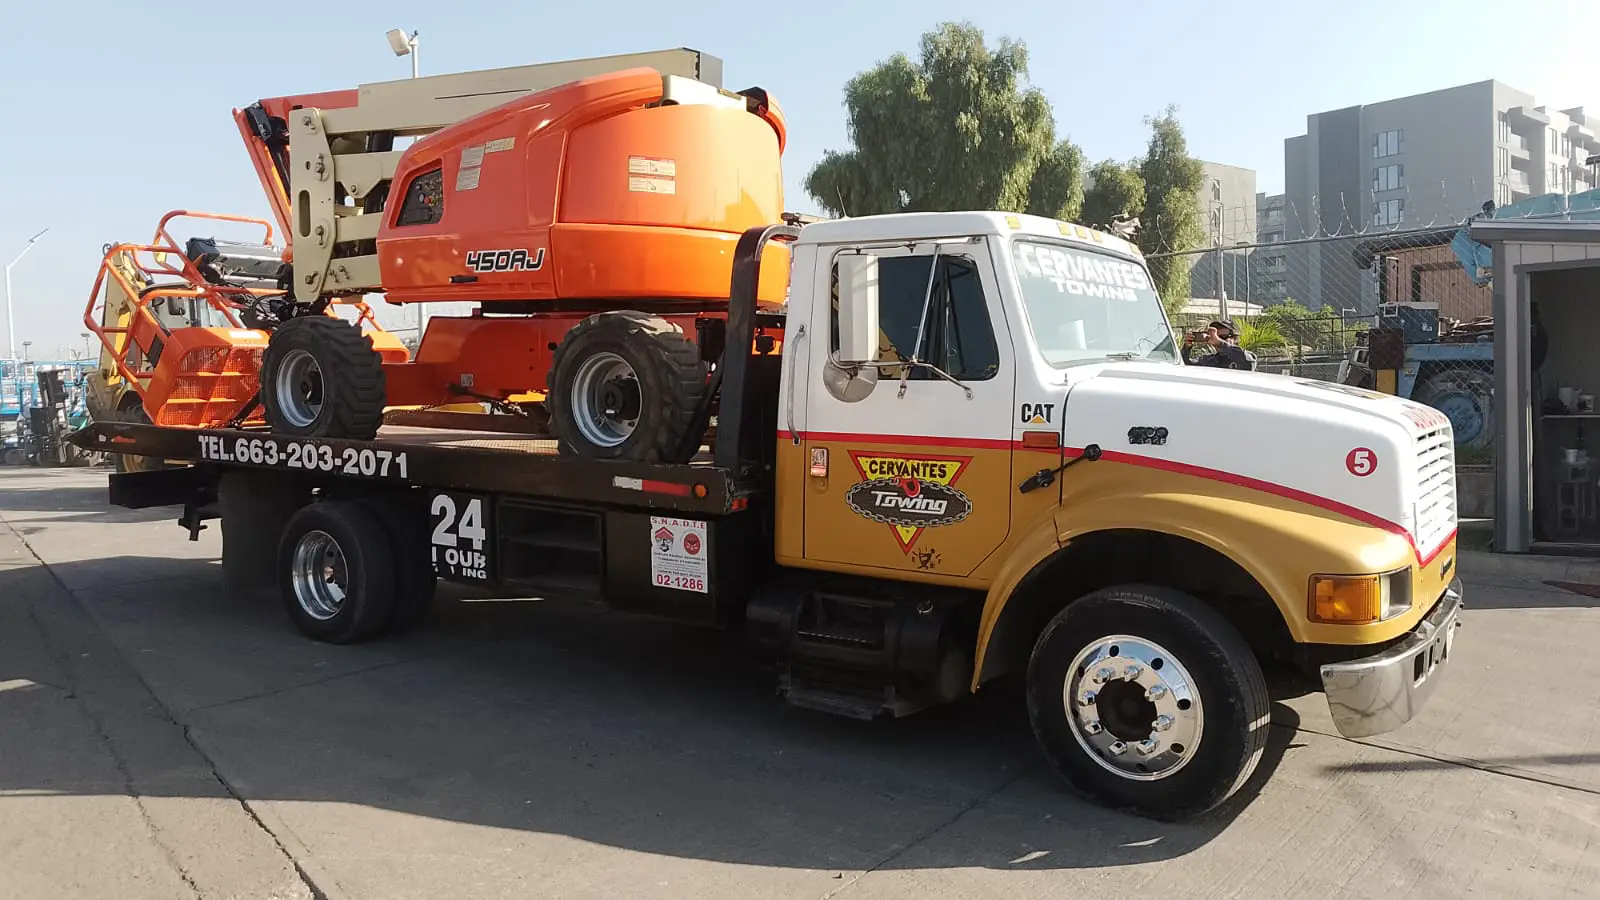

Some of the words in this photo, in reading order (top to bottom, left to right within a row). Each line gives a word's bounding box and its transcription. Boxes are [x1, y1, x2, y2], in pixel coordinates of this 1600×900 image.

[466, 248, 545, 272] 450AJ
[1018, 244, 1148, 290] CERVANTES
[1050, 276, 1137, 301] TOWING
[1021, 403, 1054, 424] CAT
[868, 460, 947, 479] CERVANTES
[1354, 451, 1371, 475] 5
[871, 490, 948, 515] Towing
[431, 494, 486, 550] 24
[657, 574, 704, 591] 02-1286
